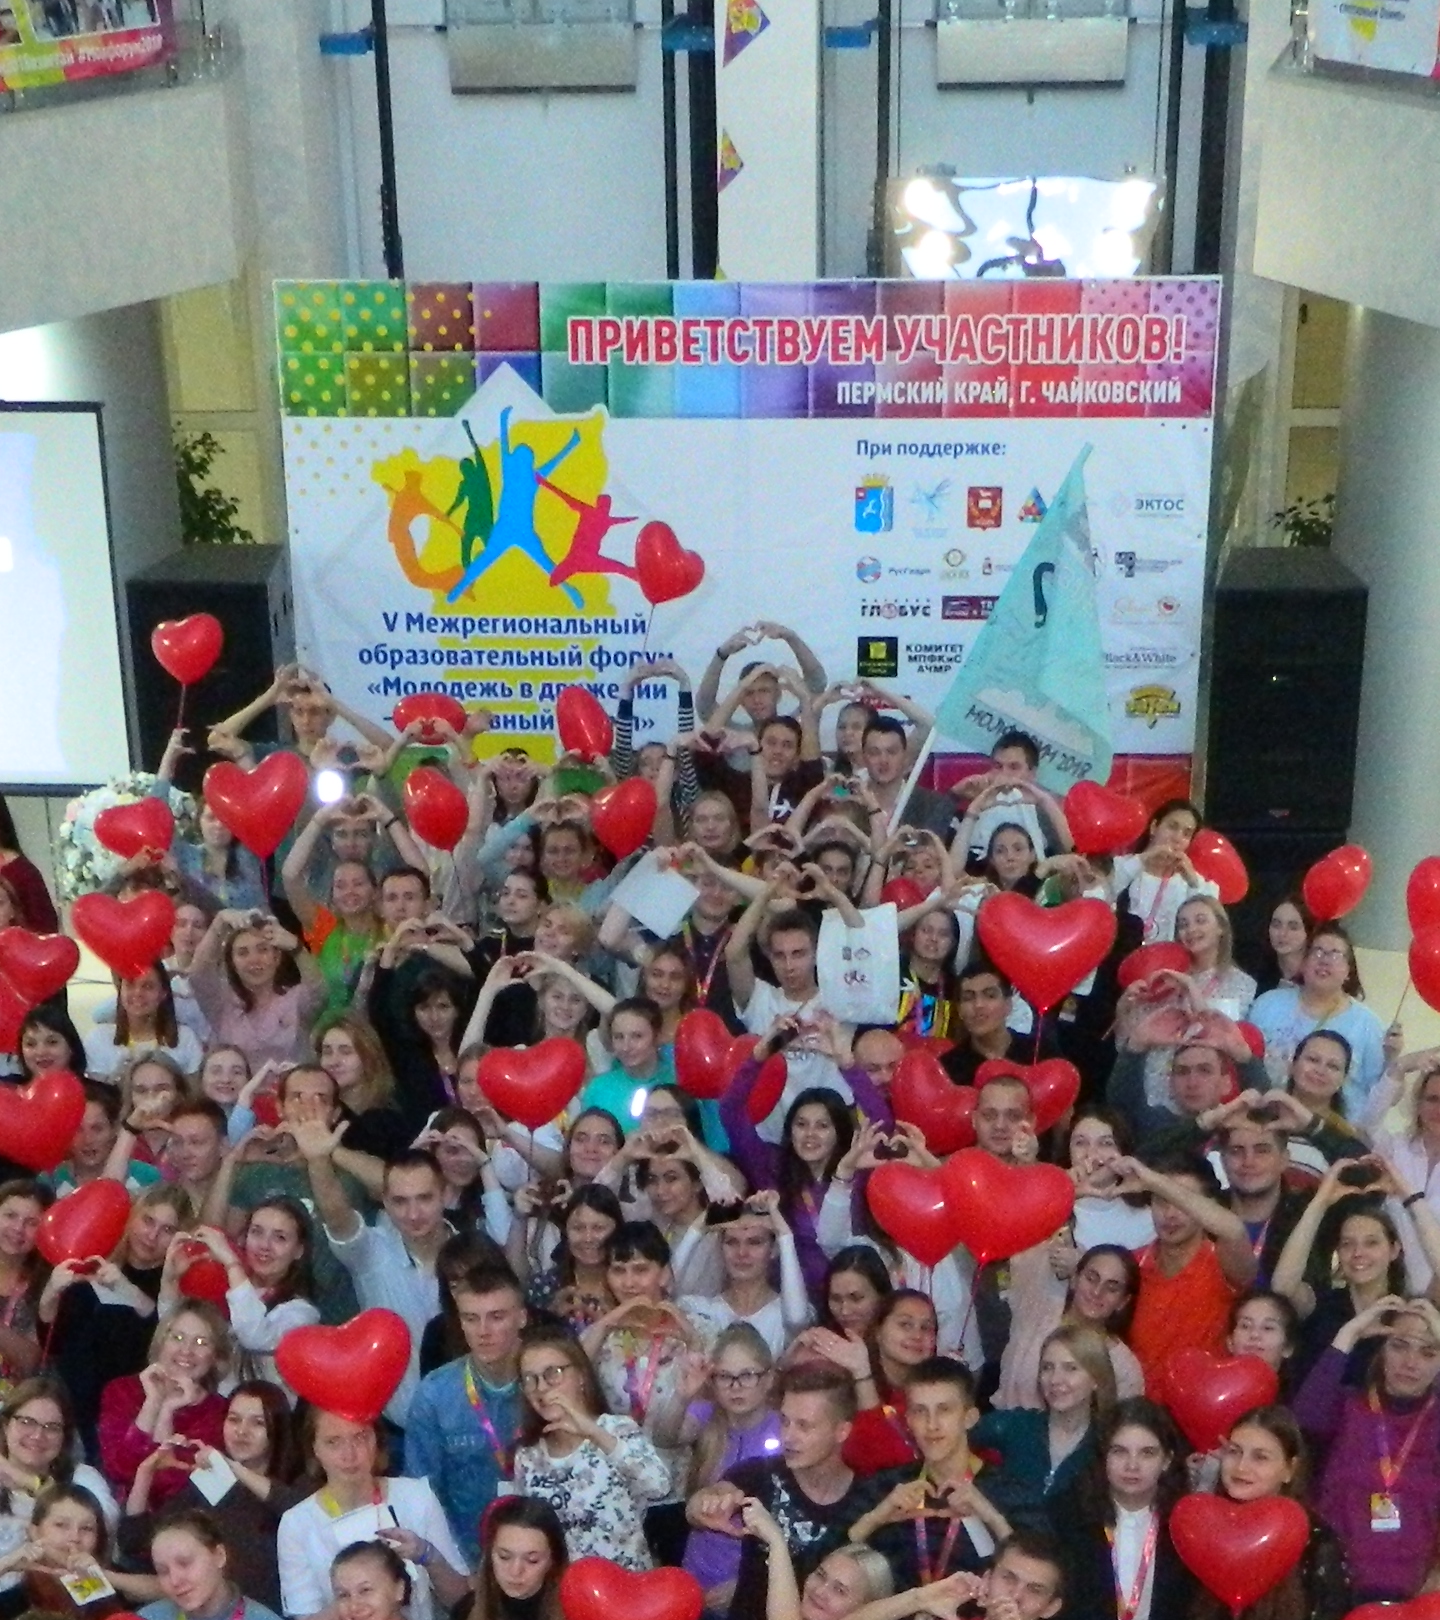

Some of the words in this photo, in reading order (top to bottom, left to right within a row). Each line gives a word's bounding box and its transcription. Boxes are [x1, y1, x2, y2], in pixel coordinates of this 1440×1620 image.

[568, 316, 887, 365] ПРИВЕТСТВУЕМ
[894, 314, 1187, 365] УЧАСТНИКОВ!
[837, 376, 948, 405] ПЕРМСКИЙ
[955, 375, 1014, 409] КРАЙ,
[1042, 376, 1182, 404] ЧАЙКОВСКИЙ
[856, 440, 892, 459] При
[896, 440, 1007, 459] поддержке:
[382, 612, 399, 633] V
[405, 612, 647, 639] Межрегиональный
[358, 644, 583, 667] образовательный
[520, 682, 534, 698] в
